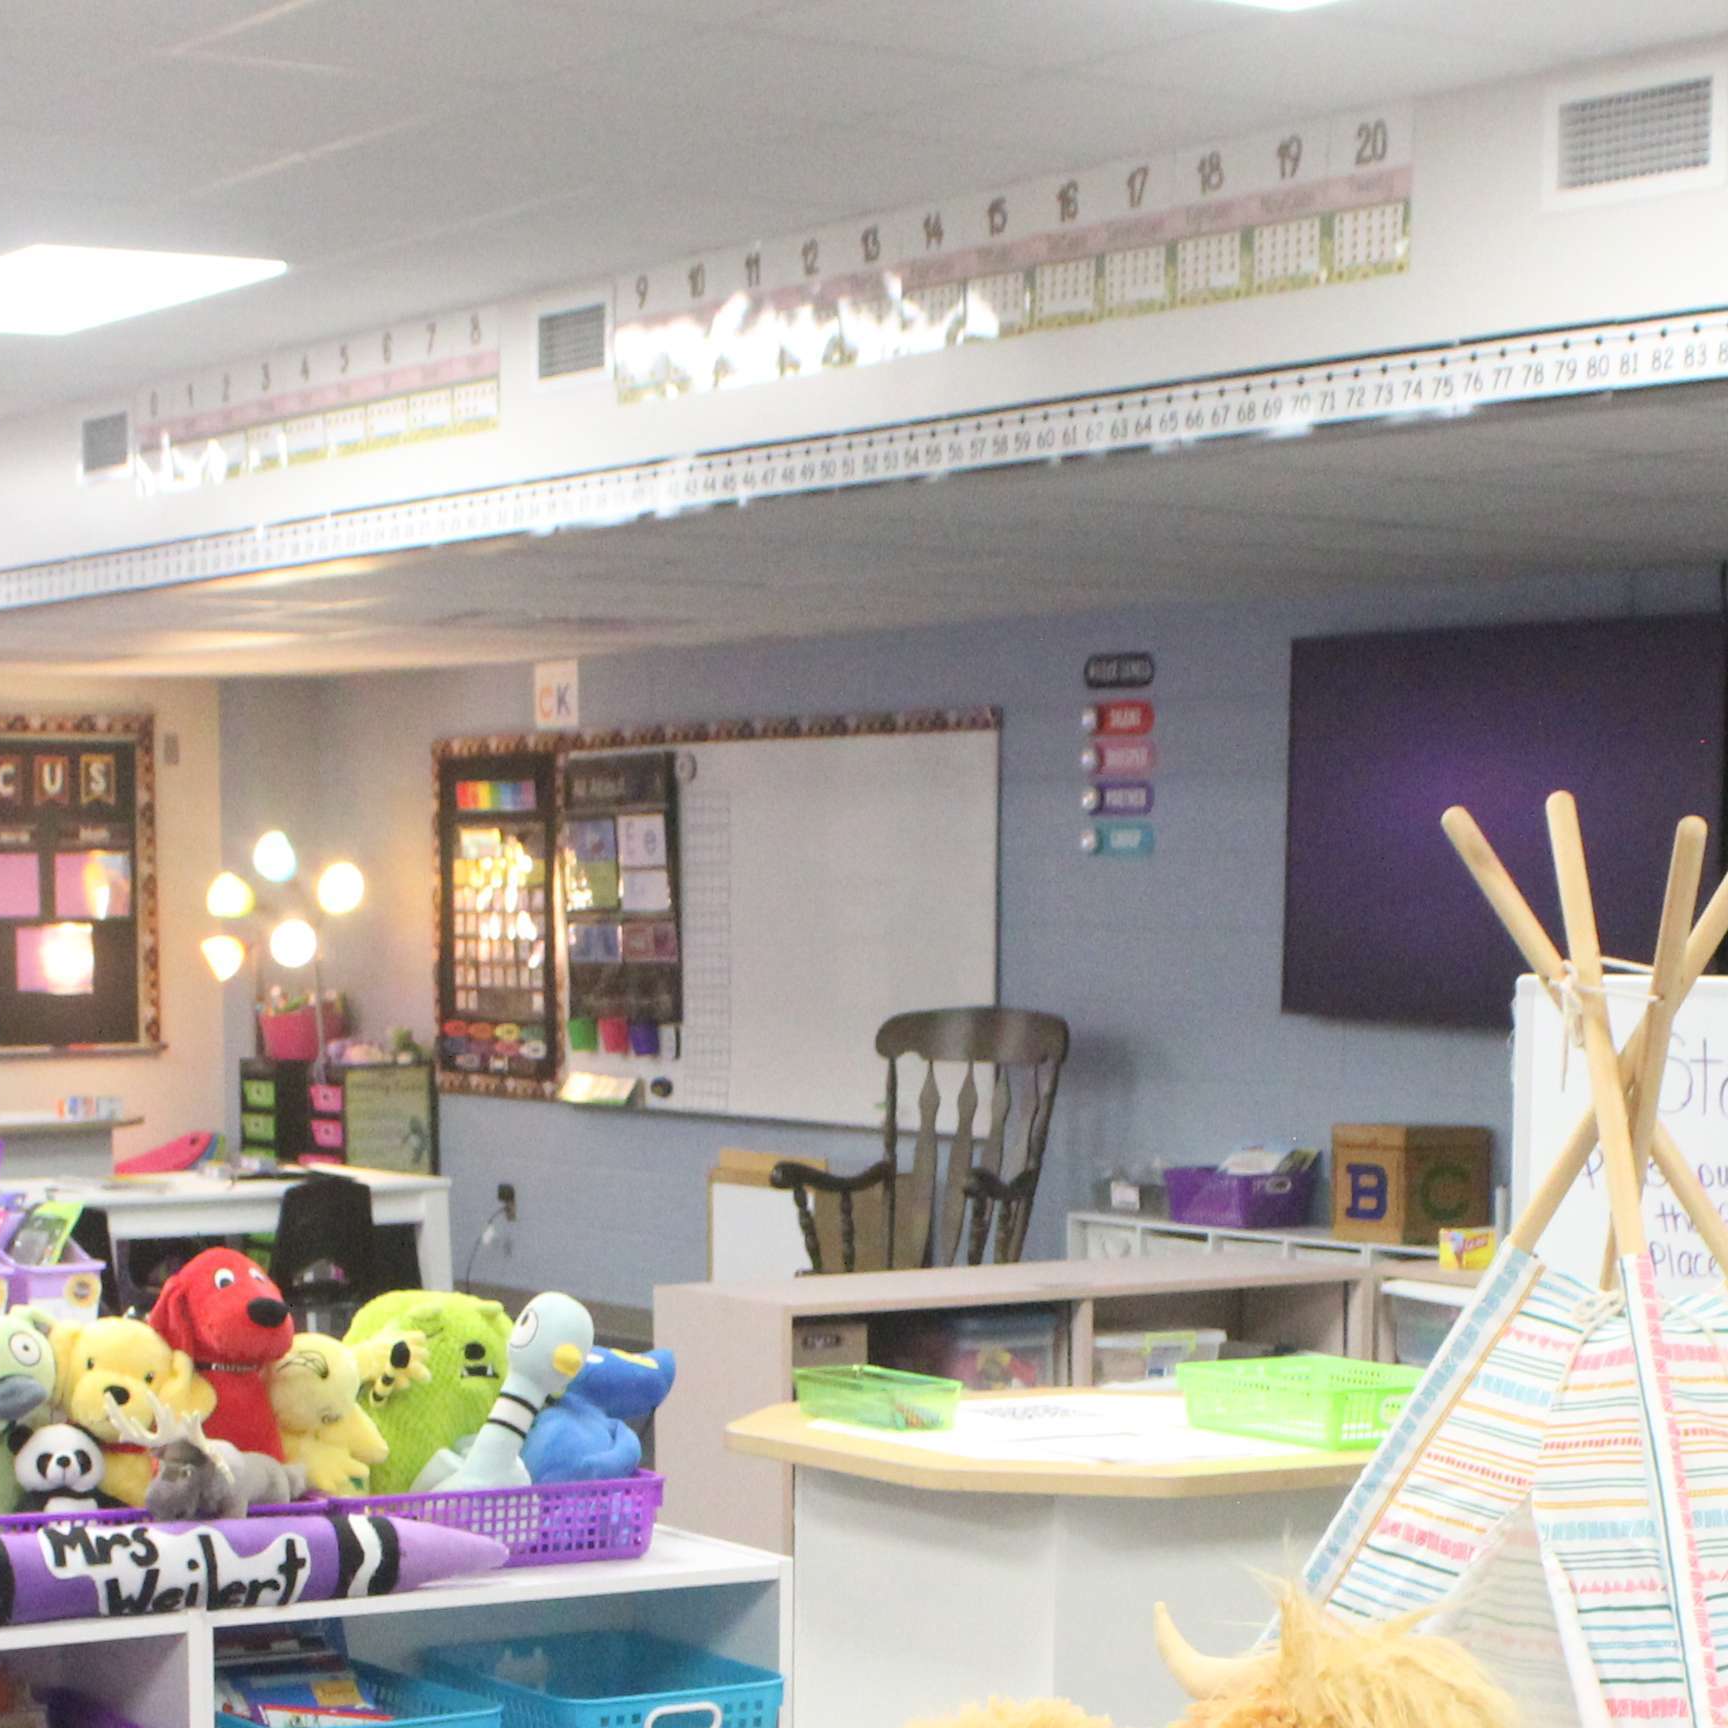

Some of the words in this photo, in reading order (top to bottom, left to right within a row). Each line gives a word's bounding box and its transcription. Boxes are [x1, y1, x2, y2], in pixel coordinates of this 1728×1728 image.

[635, 273, 649, 310] 9
[687, 262, 706, 299] 10
[744, 251, 761, 288] 11
[800, 237, 820, 276] 12
[860, 223, 881, 264] 13
[923, 211, 944, 250] 14
[987, 196, 1008, 237] 15
[1056, 178, 1080, 223] 16
[1126, 164, 1150, 209] 17
[1196, 150, 1225, 197] 18
[1276, 133, 1304, 179] 19
[1354, 118, 1388, 167] 20
[261, 361, 271, 392] 3
[301, 352, 310, 382] 4
[339, 344, 350, 374] 5
[425, 321, 437, 355] 7
[470, 311, 481, 346] 8
[970, 438, 986, 459] 57
[992, 434, 1008, 456] 58
[1014, 431, 1031, 453] 59
[1037, 428, 1055, 450] 60
[1062, 425, 1077, 446] 61
[1110, 418, 1128, 440] 63
[1135, 415, 1152, 437] 64
[1159, 411, 1178, 433] 65
[1185, 408, 1203, 430] 66
[1211, 404, 1229, 426] 67
[1237, 400, 1256, 423] 68
[1263, 397, 1282, 419] 69
[1291, 393, 1311, 416] 70
[1318, 389, 1335, 412] 71
[1347, 385, 1365, 408] 72
[1375, 381, 1394, 404] 73
[1404, 377, 1422, 400] 74
[1433, 373, 1454, 397] 75
[1464, 370, 1483, 393] 76
[1493, 366, 1512, 390] 77
[1523, 362, 1544, 386] 78
[1556, 358, 1577, 382] 79
[1586, 354, 1609, 379] 80
[1619, 351, 1638, 375] 81
[1651, 347, 1673, 371] 82
[1684, 342, 1707, 367] 83
[1346, 1164, 1387, 1220] B
[1649, 1240, 1722, 1279] Place
[41, 1526, 159, 1567] Mrs
